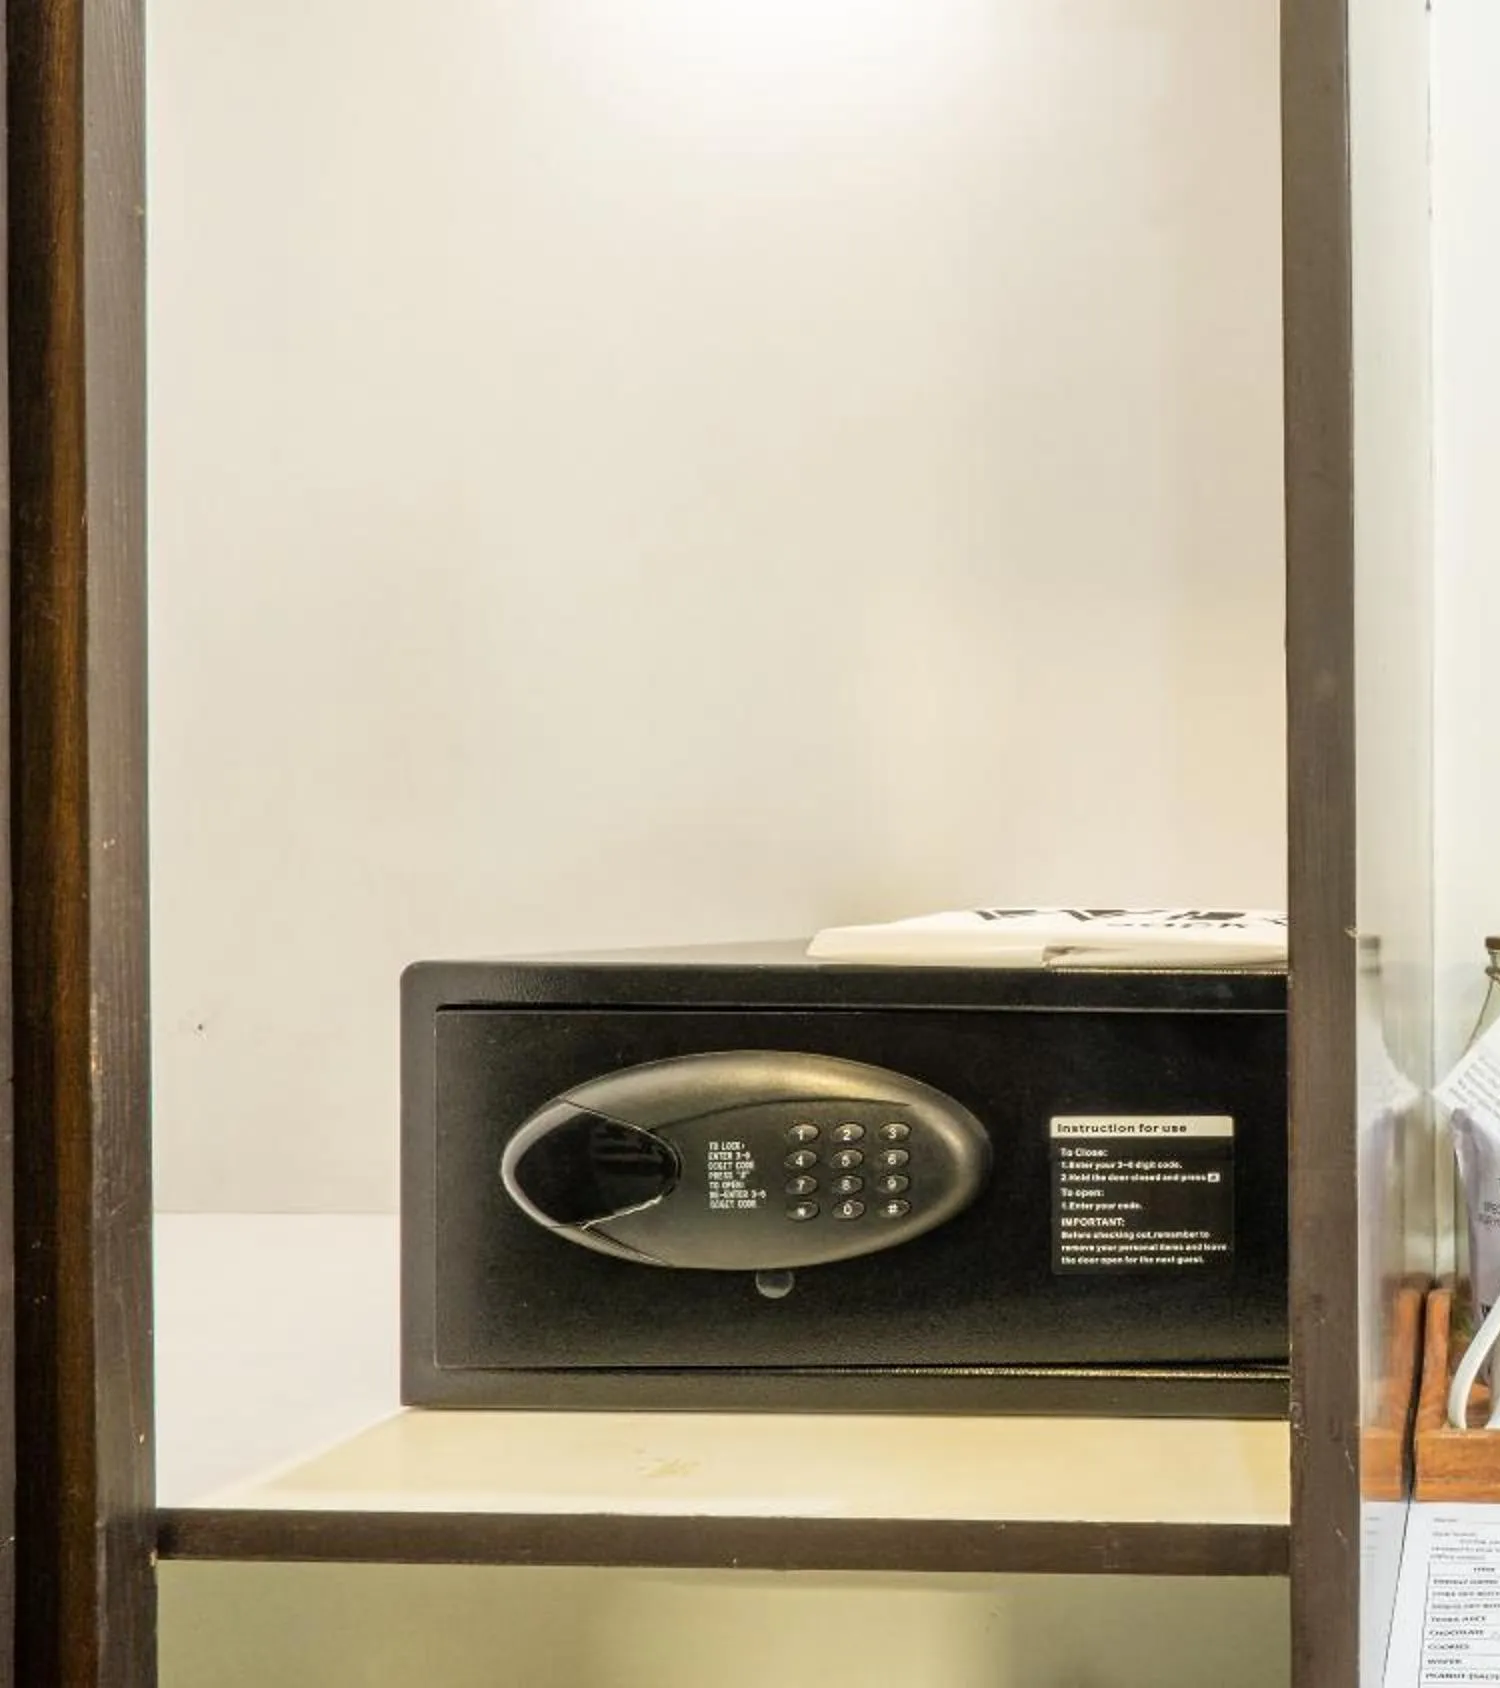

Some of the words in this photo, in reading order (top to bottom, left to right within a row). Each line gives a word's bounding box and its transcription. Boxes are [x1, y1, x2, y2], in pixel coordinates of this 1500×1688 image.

[887, 1127, 898, 1139] 3
[1057, 1122, 1135, 1134] Instruction
[1139, 1122, 1160, 1134] for
[1162, 1123, 1188, 1134] use
[797, 1128, 805, 1141] 1
[842, 1128, 852, 1141] 2
[1060, 1147, 1073, 1158] To
[795, 1154, 804, 1167] 4
[841, 1155, 851, 1167] 5
[887, 1153, 897, 1165] 6
[887, 1177, 897, 1190] 9
[1091, 1173, 1107, 1182] the
[1107, 1173, 1130, 1182] door
[1162, 1173, 1180, 1182] and
[797, 1178, 806, 1192] 7
[841, 1179, 851, 1191] 8
[1060, 1187, 1073, 1198] To
[1075, 1189, 1105, 1199] open:
[842, 1202, 853, 1215] 0
[1060, 1217, 1127, 1228] IMPORTANT:
[1060, 1230, 1092, 1240] Before
[1093, 1230, 1135, 1241] checking
